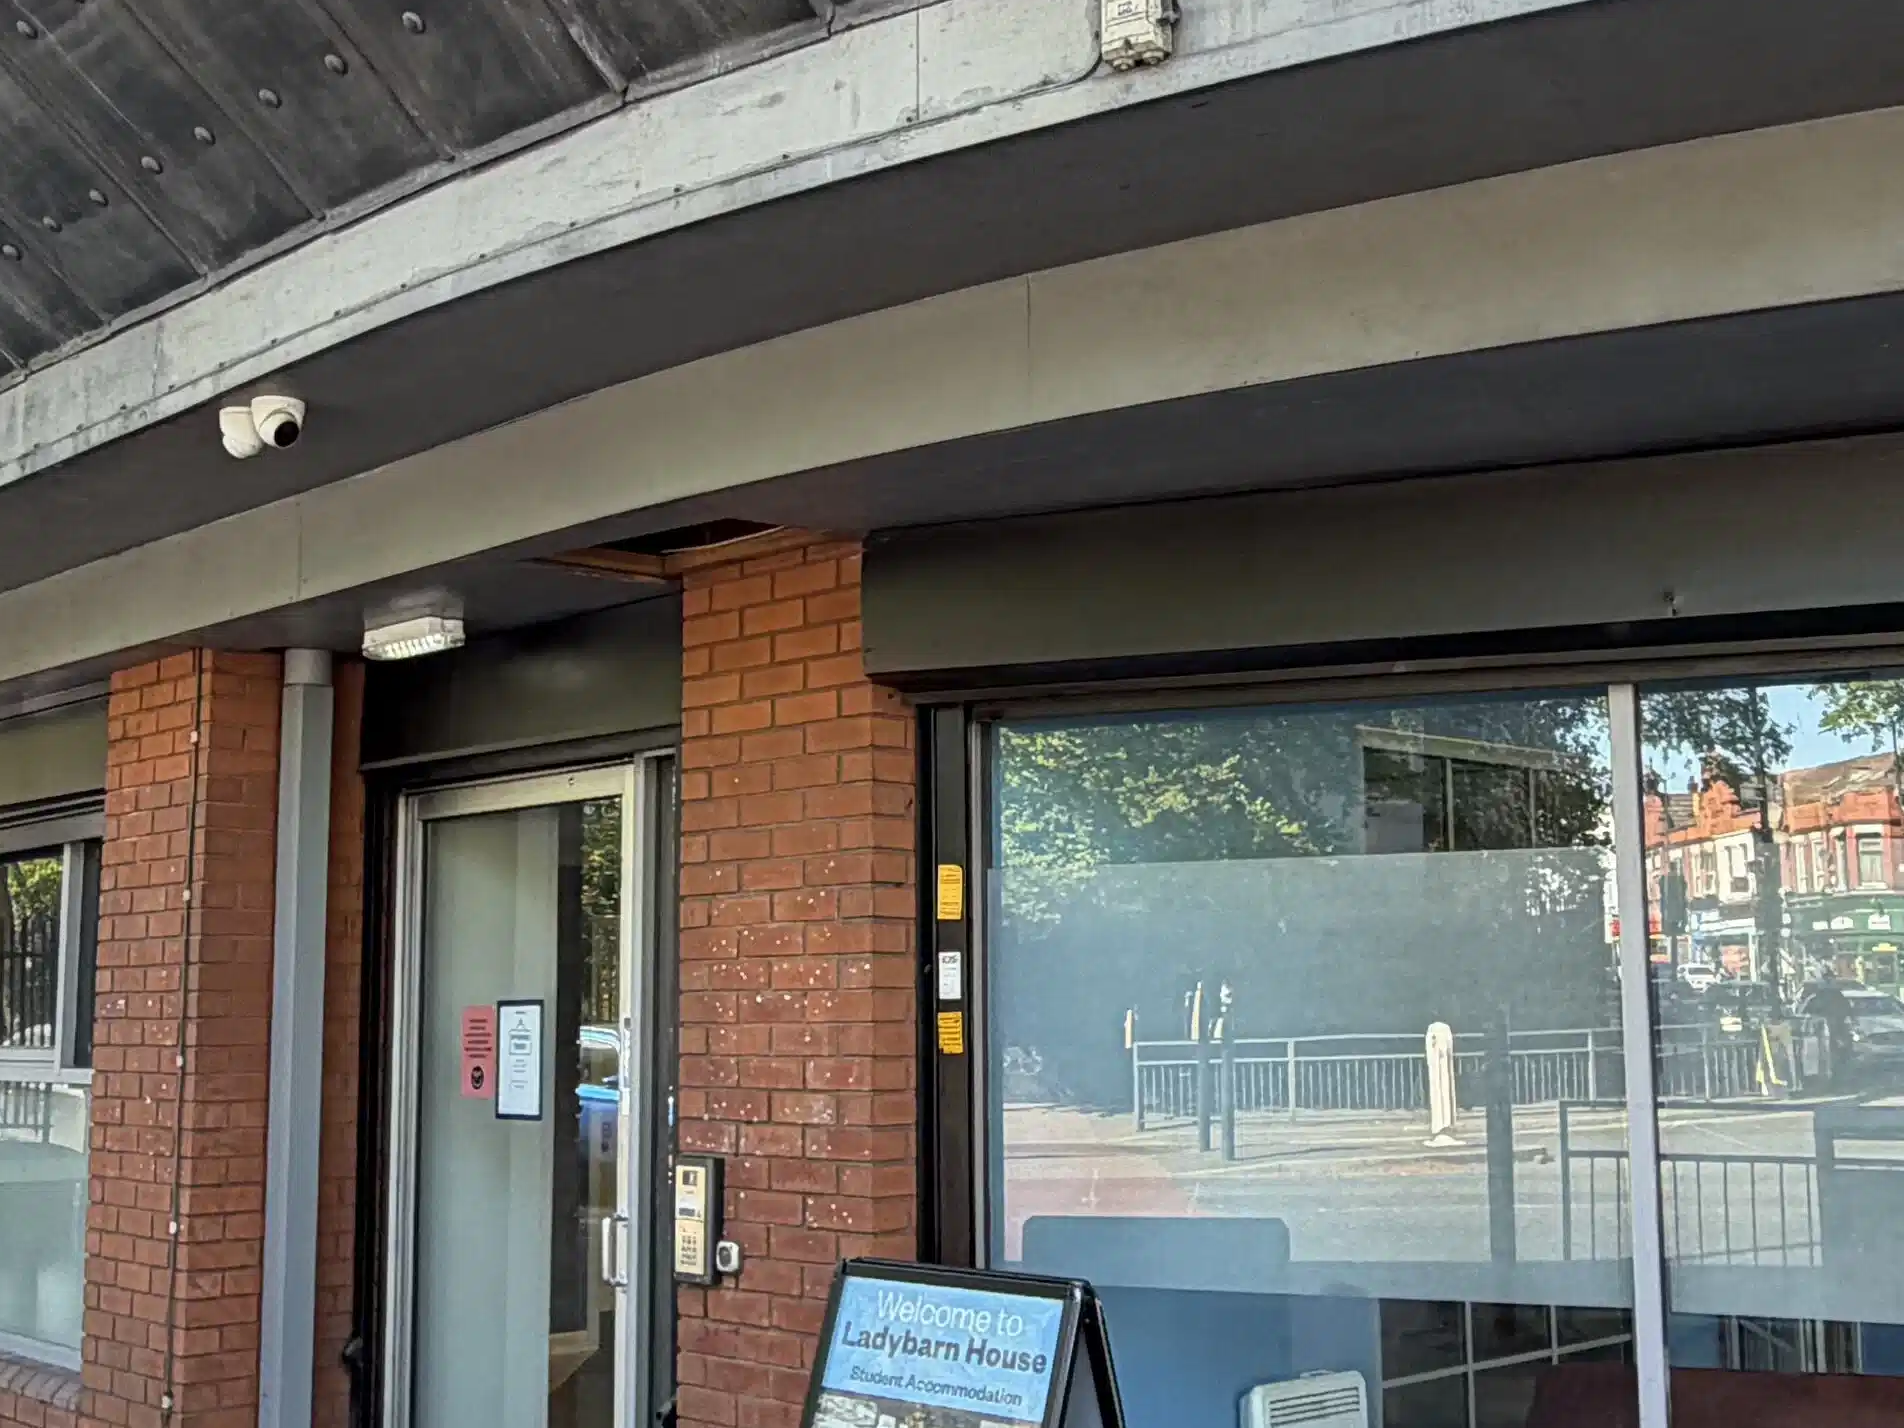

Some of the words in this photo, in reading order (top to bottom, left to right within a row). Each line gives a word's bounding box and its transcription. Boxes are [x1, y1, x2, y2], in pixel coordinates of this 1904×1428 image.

[878, 1290, 991, 1334] Welcome
[997, 1305, 1024, 1337] to
[841, 1320, 960, 1362] Ladybarn
[964, 1335, 1048, 1375] House
[849, 1365, 904, 1389] Student
